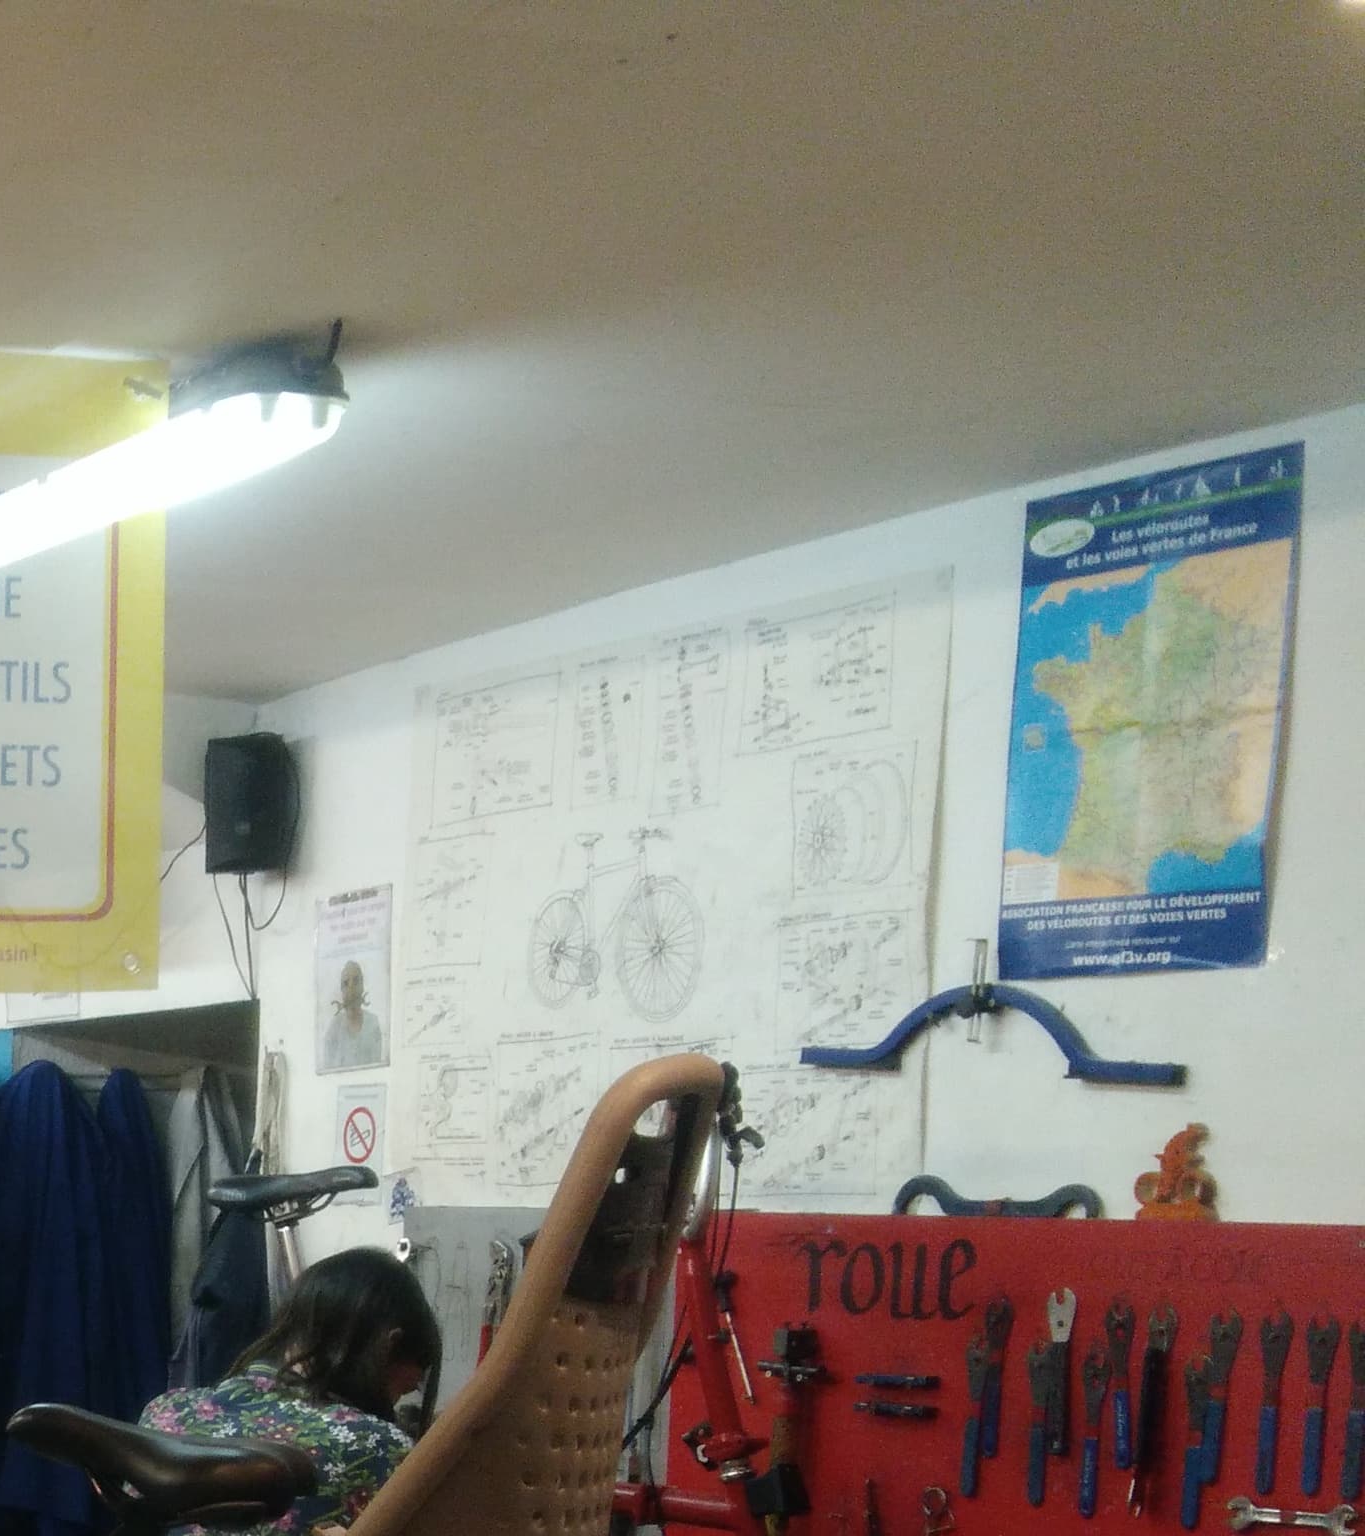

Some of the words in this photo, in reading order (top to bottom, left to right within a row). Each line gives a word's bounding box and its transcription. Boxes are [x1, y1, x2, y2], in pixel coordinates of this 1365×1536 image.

[1112, 529, 1133, 543] Les
[1188, 530, 1207, 545] de
[1211, 522, 1258, 543] France
[797, 1235, 979, 1321] roue
